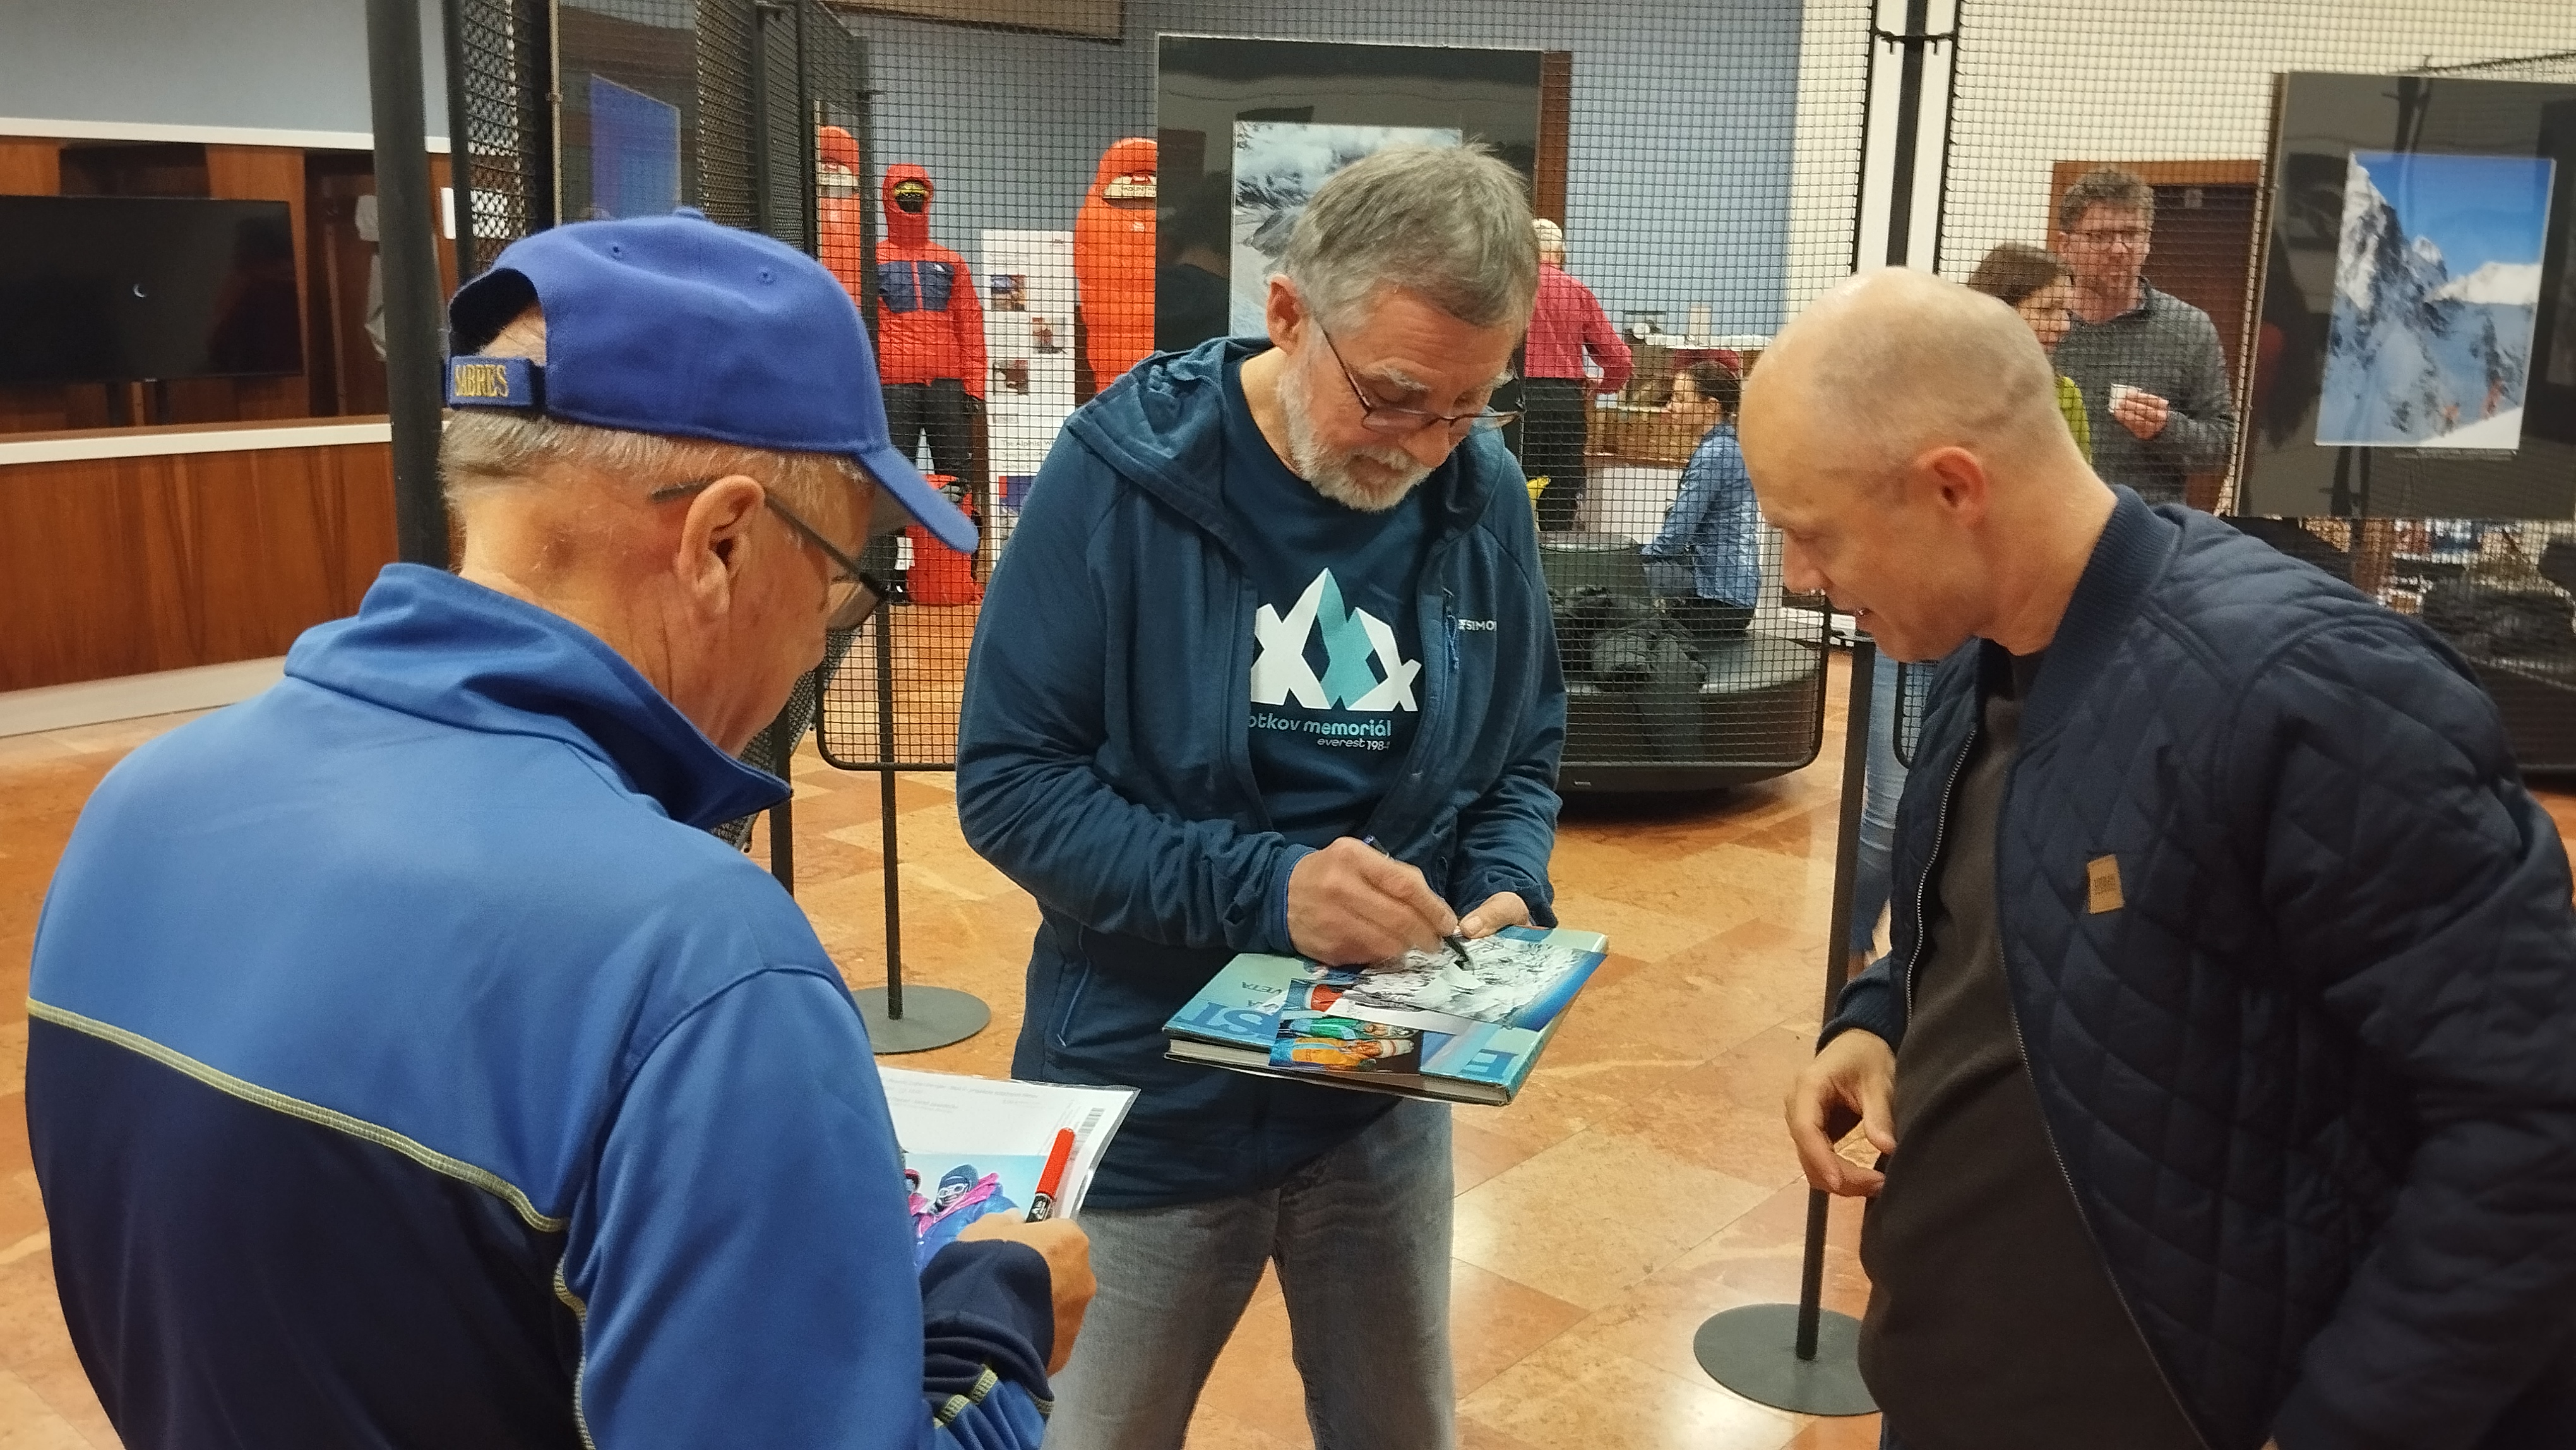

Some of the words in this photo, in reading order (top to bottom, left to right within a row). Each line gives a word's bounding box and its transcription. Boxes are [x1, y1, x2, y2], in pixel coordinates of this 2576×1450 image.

[1249, 713, 1301, 731] otkov
[1303, 719, 1392, 736] memoriál
[1317, 738, 1366, 748] everest
